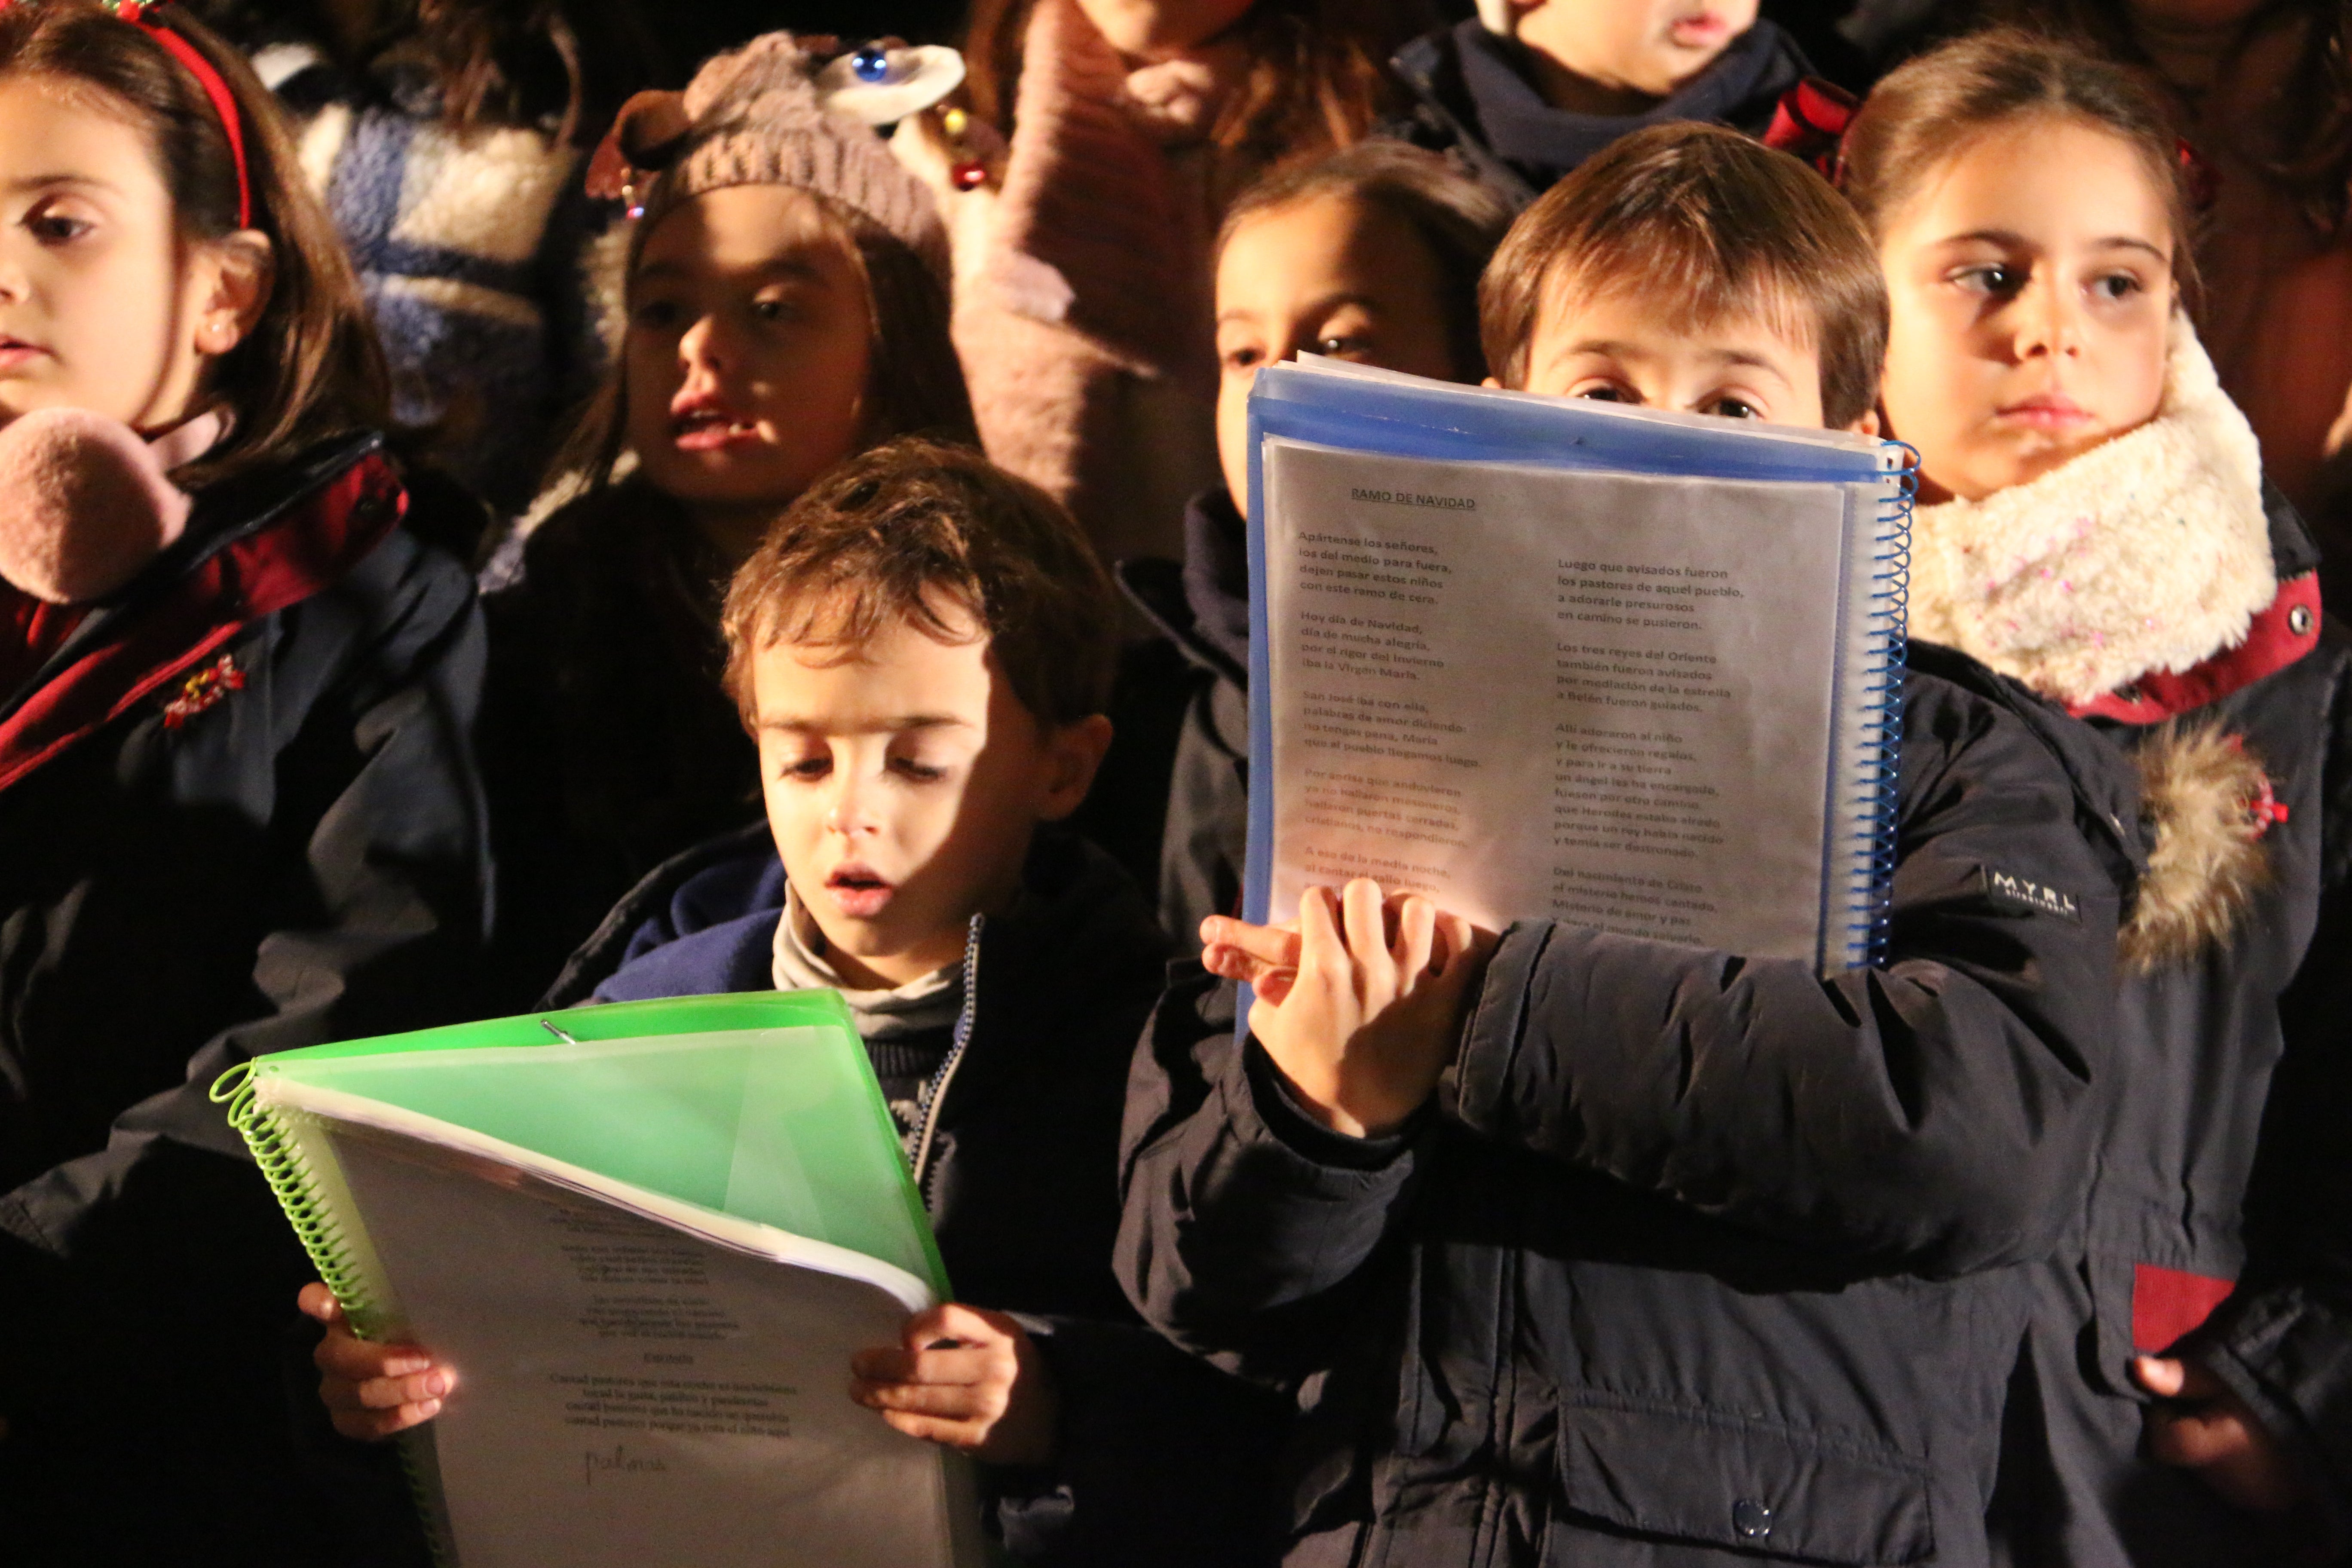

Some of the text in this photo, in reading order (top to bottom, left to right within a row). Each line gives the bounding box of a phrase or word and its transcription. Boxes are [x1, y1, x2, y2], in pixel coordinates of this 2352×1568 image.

[1351, 488, 1476, 509] RAMO DE NAVIDAD
[1297, 530, 1361, 545] Apártense
[1364, 536, 1382, 548] los
[1298, 546, 1317, 557] los
[1320, 549, 1338, 560] del
[1342, 552, 1379, 564] medio
[1384, 558, 1412, 568] para
[1299, 563, 1443, 588] dejen pasar estos niños
[1558, 558, 1728, 578] Luego que avisados fueron
[1300, 581, 1322, 591] con
[1326, 584, 1350, 594] este
[1354, 587, 1386, 598] ramo
[1389, 589, 1405, 600] de
[1557, 575, 1576, 585] los
[1580, 579, 1633, 590] pastores
[1637, 581, 1651, 591] de
[1656, 583, 1691, 595] aquel
[1569, 593, 1621, 606] adorarle
[1625, 600, 1694, 612] presurosos
[1300, 610, 1325, 624] Hoy
[1350, 616, 1364, 626] de
[1557, 611, 1574, 619] en
[1577, 611, 1622, 623] camino
[1626, 616, 1639, 625] se
[1323, 628, 1337, 639] de
[1341, 633, 1381, 644] mucha
[1300, 643, 1444, 668] por el rigor del invierno
[1556, 641, 1717, 663] Los tres reyes del Oriente
[1302, 656, 1321, 668] iba
[1324, 659, 1334, 669] la
[1338, 661, 1376, 675] Virgen
[1613, 662, 1654, 675] fueron
[1657, 667, 1712, 680] avisados
[1556, 676, 1577, 686] por
[1650, 682, 1665, 692] de
[1668, 683, 1679, 693] la
[1684, 686, 1731, 698] estrella
[1606, 695, 1647, 707] fueron
